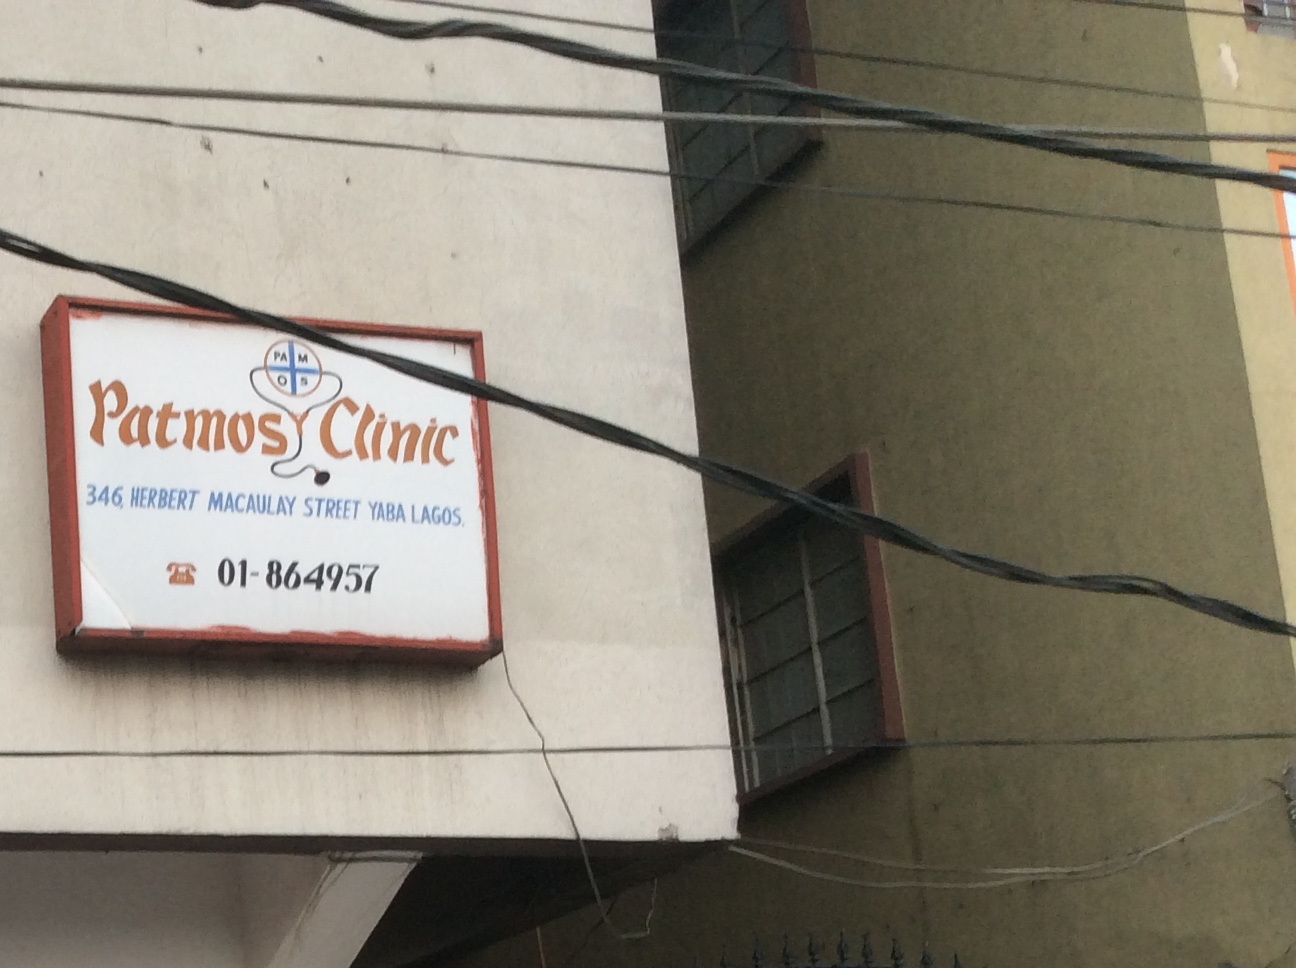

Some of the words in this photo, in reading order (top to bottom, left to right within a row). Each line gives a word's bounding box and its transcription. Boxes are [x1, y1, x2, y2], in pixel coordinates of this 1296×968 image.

[273, 351, 288, 363] PA
[297, 353, 309, 363] M
[276, 374, 288, 387] O
[88, 379, 288, 457] Patmos
[319, 396, 460, 467] Clinic
[86, 484, 124, 510] 346,
[129, 486, 201, 512] HERBERT
[207, 490, 297, 517] MACAULAY
[303, 495, 362, 521] STREET
[368, 501, 406, 524] YABA
[411, 504, 465, 528] LAGOS.
[217, 556, 381, 595] 01-864957
